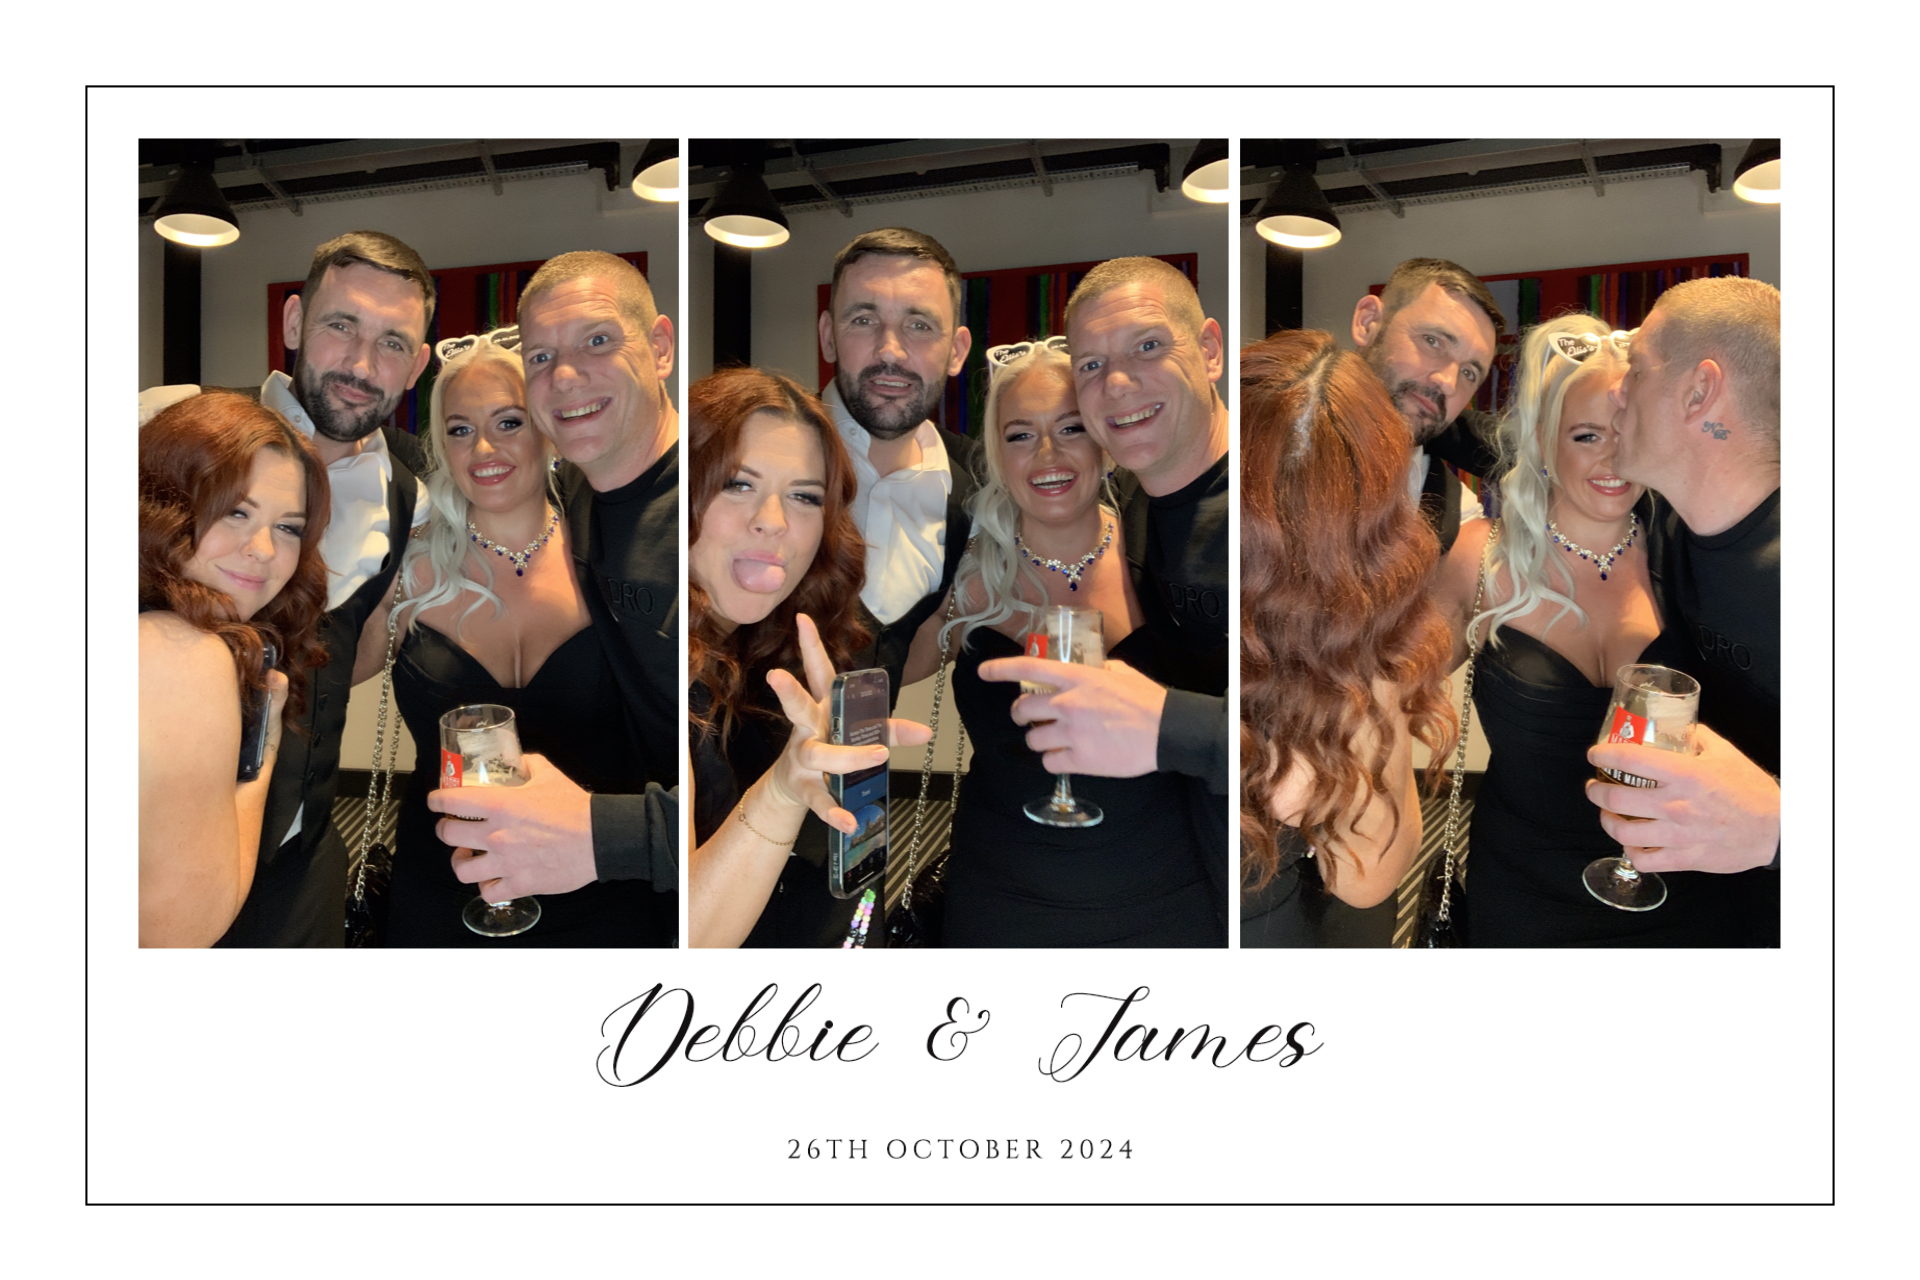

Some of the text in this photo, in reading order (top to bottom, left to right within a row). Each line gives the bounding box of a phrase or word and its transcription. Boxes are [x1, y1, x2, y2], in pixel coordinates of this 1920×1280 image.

[1558, 338, 1575, 347] The
[995, 349, 1010, 357] The
[1613, 768, 1622, 781] DE
[1624, 773, 1657, 789] MADRID
